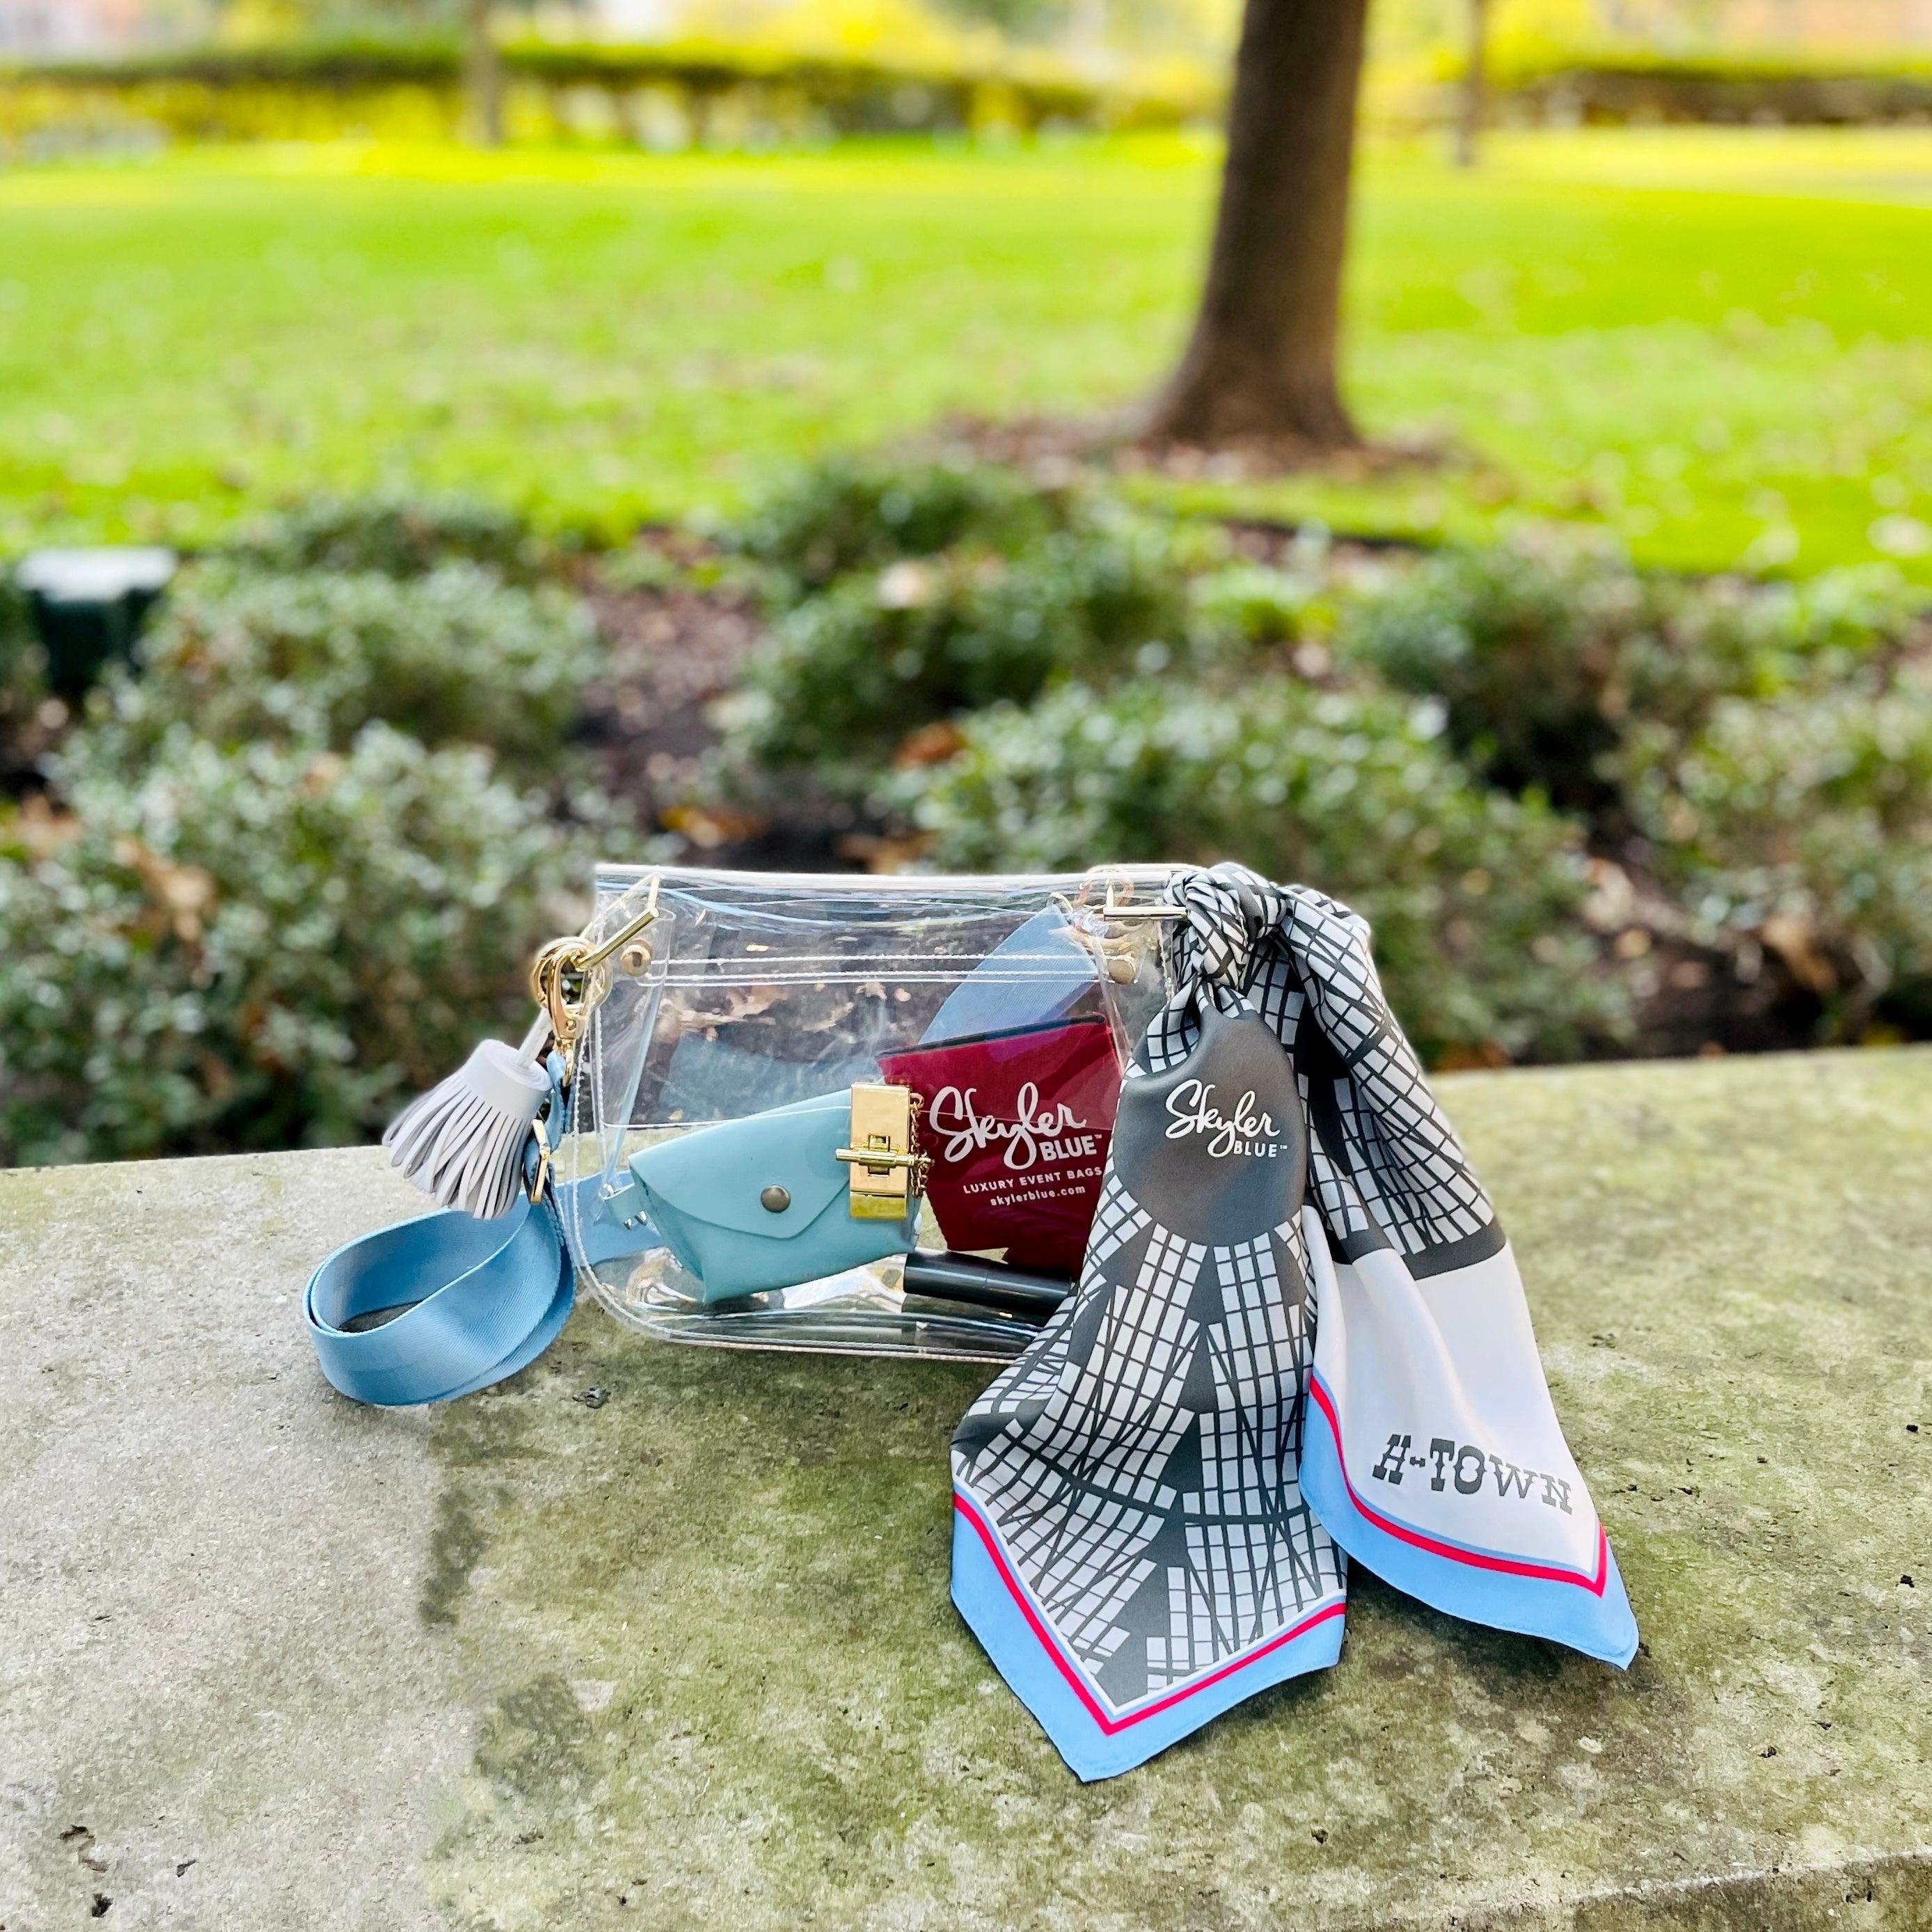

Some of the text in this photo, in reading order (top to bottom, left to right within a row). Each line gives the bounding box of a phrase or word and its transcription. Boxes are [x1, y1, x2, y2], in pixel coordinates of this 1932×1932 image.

[928, 1082, 1087, 1171] Skyler
[1164, 1079, 1281, 1158] Skyler
[963, 1166, 1102, 1194] LUXURY EVENT BAGS
[990, 1185, 1086, 1207] skylerblue.com
[1372, 1434, 1573, 1515] H-TOWN
